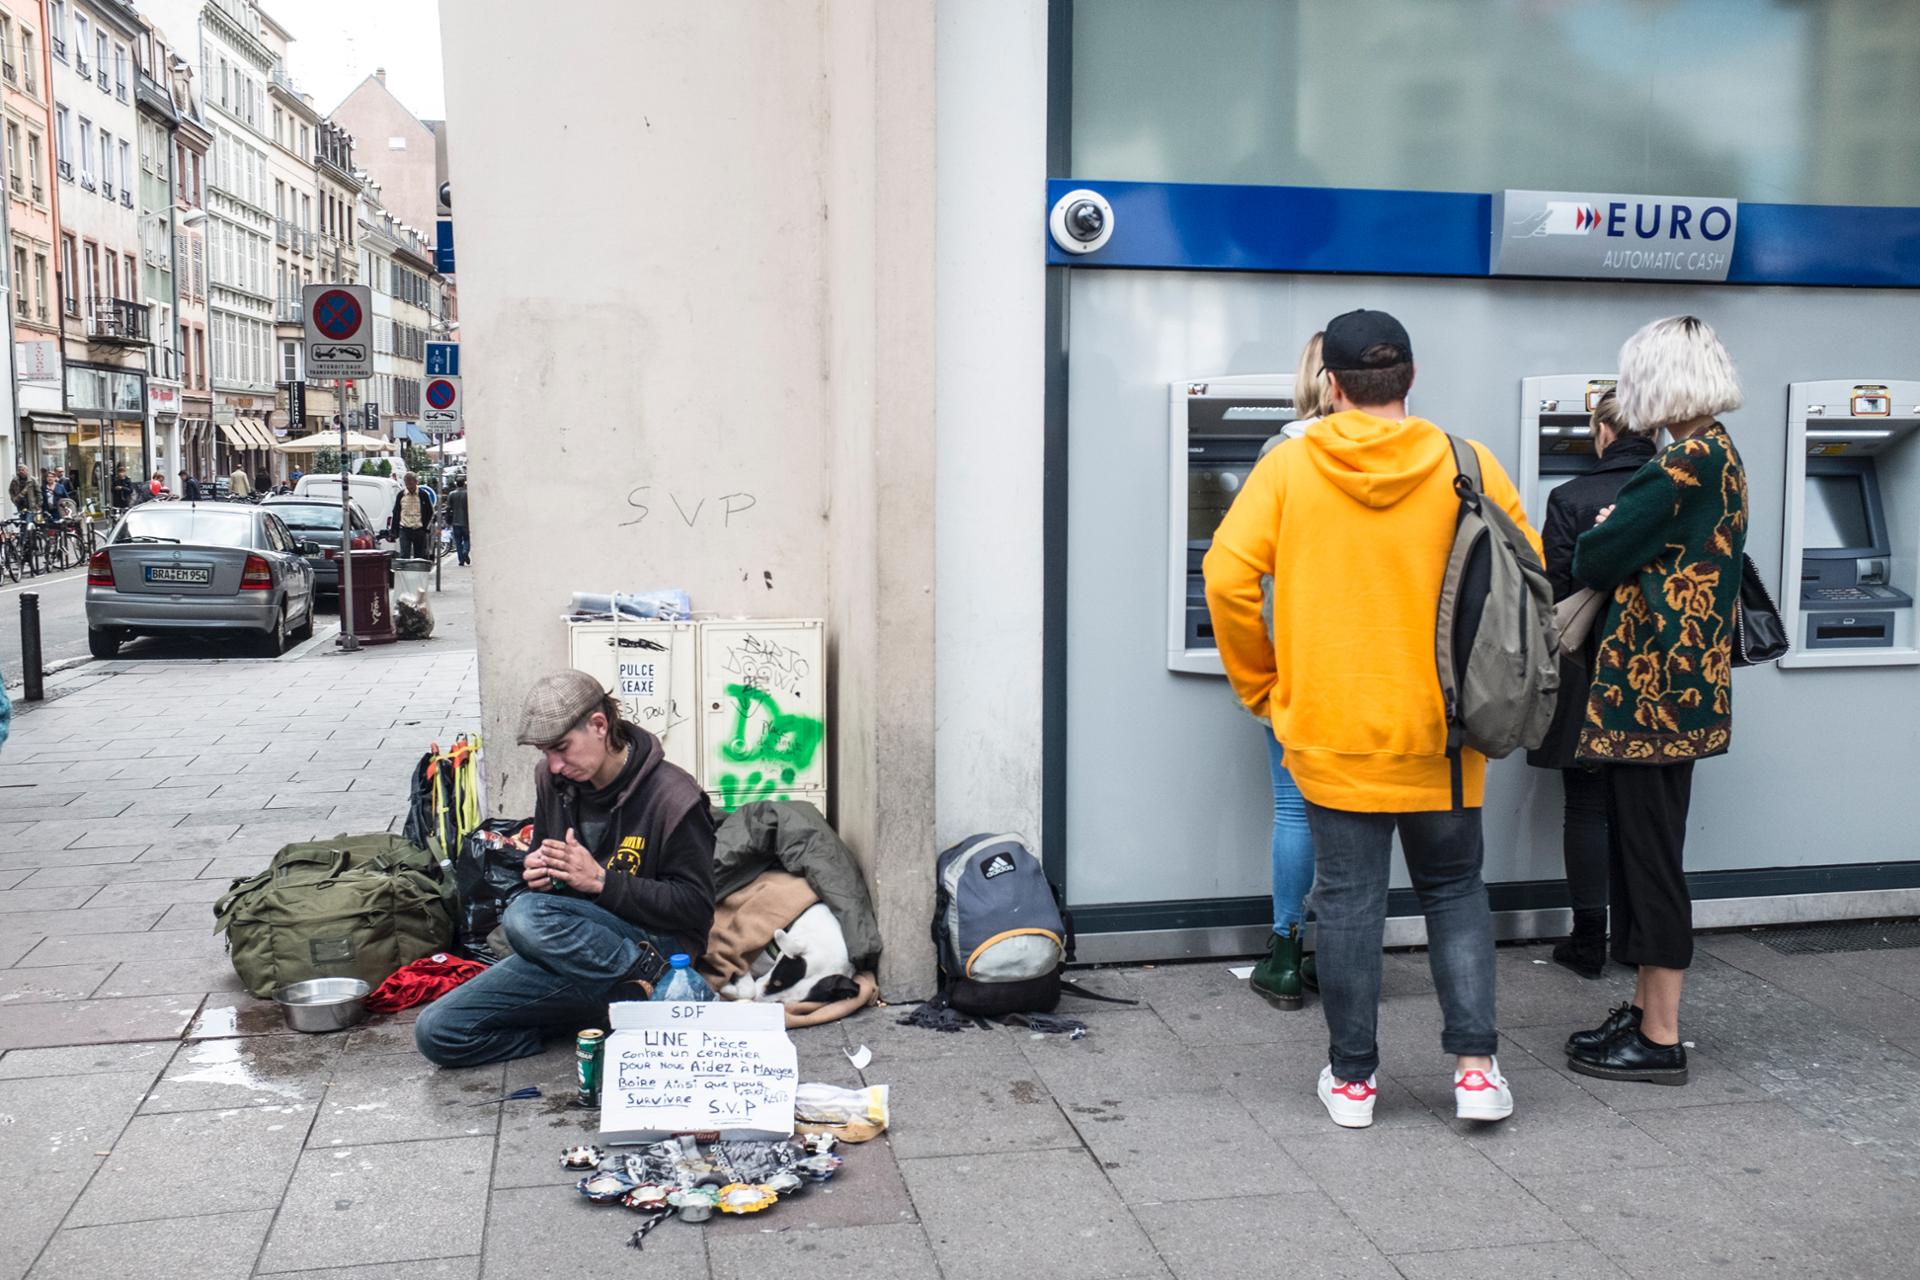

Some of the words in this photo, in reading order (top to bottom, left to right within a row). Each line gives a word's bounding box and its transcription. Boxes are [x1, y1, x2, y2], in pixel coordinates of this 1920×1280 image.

[1607, 202, 1731, 241] EURO
[1603, 250, 1685, 270] AUTOMATIC
[1687, 252, 1724, 271] CASH
[152, 567, 170, 579] BRA
[176, 569, 189, 580] EM
[190, 570, 207, 580] 954
[620, 664, 654, 676] PULCE
[985, 864, 1015, 878] adidas
[644, 1030, 688, 1047] UNE
[690, 1060, 734, 1073] Aidez
